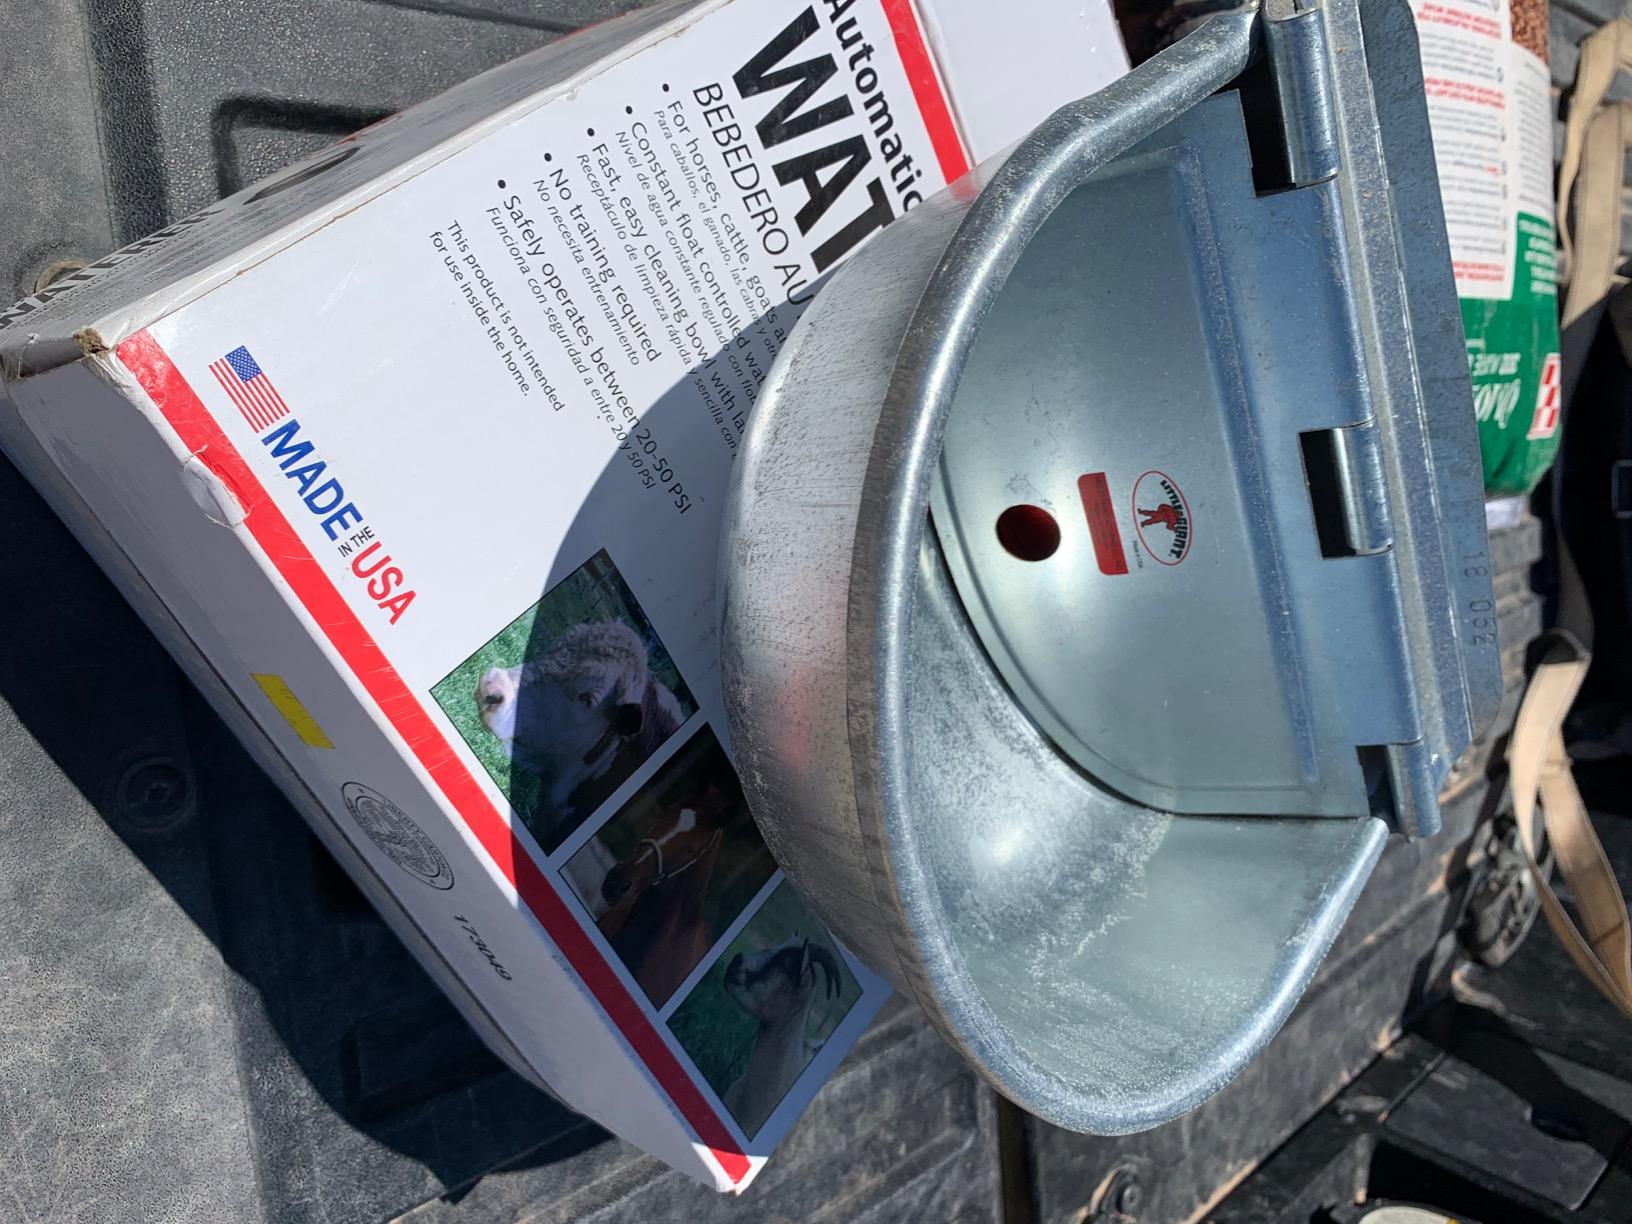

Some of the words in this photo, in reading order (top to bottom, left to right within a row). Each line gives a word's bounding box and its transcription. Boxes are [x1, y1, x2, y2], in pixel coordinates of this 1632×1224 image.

[654, 110, 672, 139] Para
[823, 0, 923, 212] Automatic
[670, 143, 699, 198] caballos,
[693, 83, 789, 256] BEBEDERO
[773, 263, 815, 310] AU
[631, 122, 681, 211] Constant
[676, 213, 704, 258] float
[699, 261, 750, 348] controlled
[667, 100, 690, 133] For
[682, 137, 720, 208] horses,
[720, 213, 749, 270] cattle,
[745, 275, 776, 323] goats
[698, 202, 711, 213] el
[486, 207, 530, 274] Funciona
[549, 168, 571, 200] No
[569, 204, 615, 283] training
[611, 285, 662, 361] required
[615, 131, 643, 168] Nivel
[636, 172, 650, 190] de
[647, 194, 668, 226] agua
[665, 230, 701, 293] constante
[698, 296, 729, 351] regulado
[728, 355, 744, 377] con
[702, 217, 731, 265] ganado,
[527, 278, 547, 303] con
[532, 179, 550, 201] No
[547, 206, 584, 264] necesita
[581, 267, 639, 365] entrenamiento
[576, 154, 626, 240] Receptáculo
[624, 244, 637, 261] de
[634, 263, 669, 321] limpieza
[665, 324, 691, 365] rápida
[694, 378, 723, 424] sencilla
[720, 427, 736, 448] con
[591, 143, 621, 192] Fast,
[619, 196, 647, 237] easy
[644, 244, 688, 323] cleaning
[684, 321, 716, 368] bowl
[710, 371, 735, 411] with
[730, 268, 743, 286] las
[429, 231, 448, 252] for
[444, 255, 463, 281] use
[460, 281, 489, 325] inside
[487, 326, 504, 351] the
[501, 350, 529, 396] home.
[447, 219, 469, 252] This
[462, 254, 504, 311] product
[500, 310, 511, 324] is
[507, 325, 527, 351] not
[522, 349, 565, 411] intended
[739, 288, 761, 325] cabras
[503, 195, 545, 255] Safely
[541, 263, 593, 346] operates
[590, 346, 639, 429] between
[635, 428, 673, 482] 20-50
[668, 482, 692, 514] PSI
[543, 307, 590, 373] seguridad
[583, 377, 593, 386] a
[591, 388, 614, 422] entre
[610, 424, 627, 441] 20
[618, 441, 632, 450] y
[626, 451, 643, 468] 50
[261, 419, 364, 542] MADE
[637, 468, 656, 489] PSI
[1160, 480, 1183, 511] LITTLE
[337, 541, 351, 558] IN
[350, 526, 375, 549] THE
[1170, 517, 1188, 559] GIANT
[351, 541, 416, 625] USA
[454, 914, 513, 981] 173049
